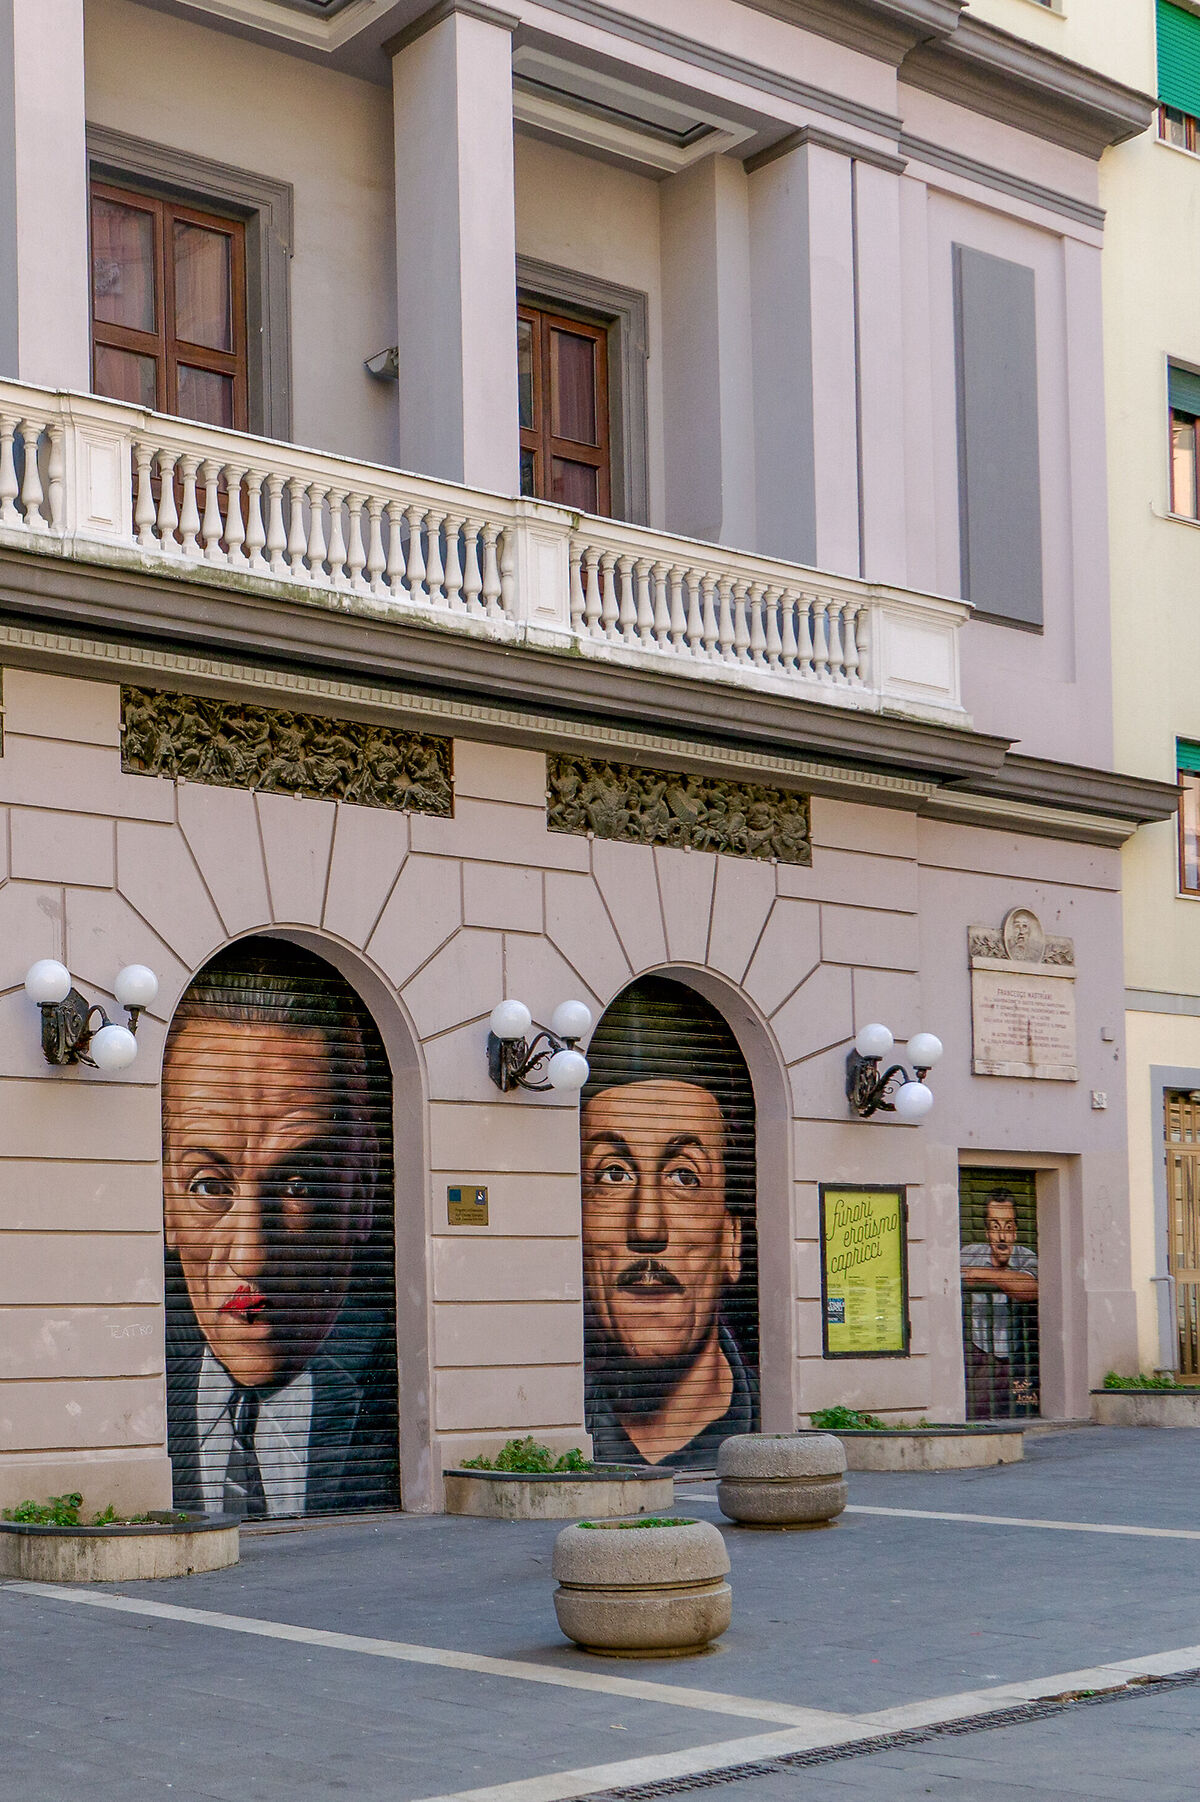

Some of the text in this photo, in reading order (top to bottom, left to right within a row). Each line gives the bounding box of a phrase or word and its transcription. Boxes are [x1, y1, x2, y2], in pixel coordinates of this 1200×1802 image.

[826, 1196, 874, 1241] furori
[844, 1213, 898, 1248] erotismo
[831, 1236, 883, 1280] capricci
